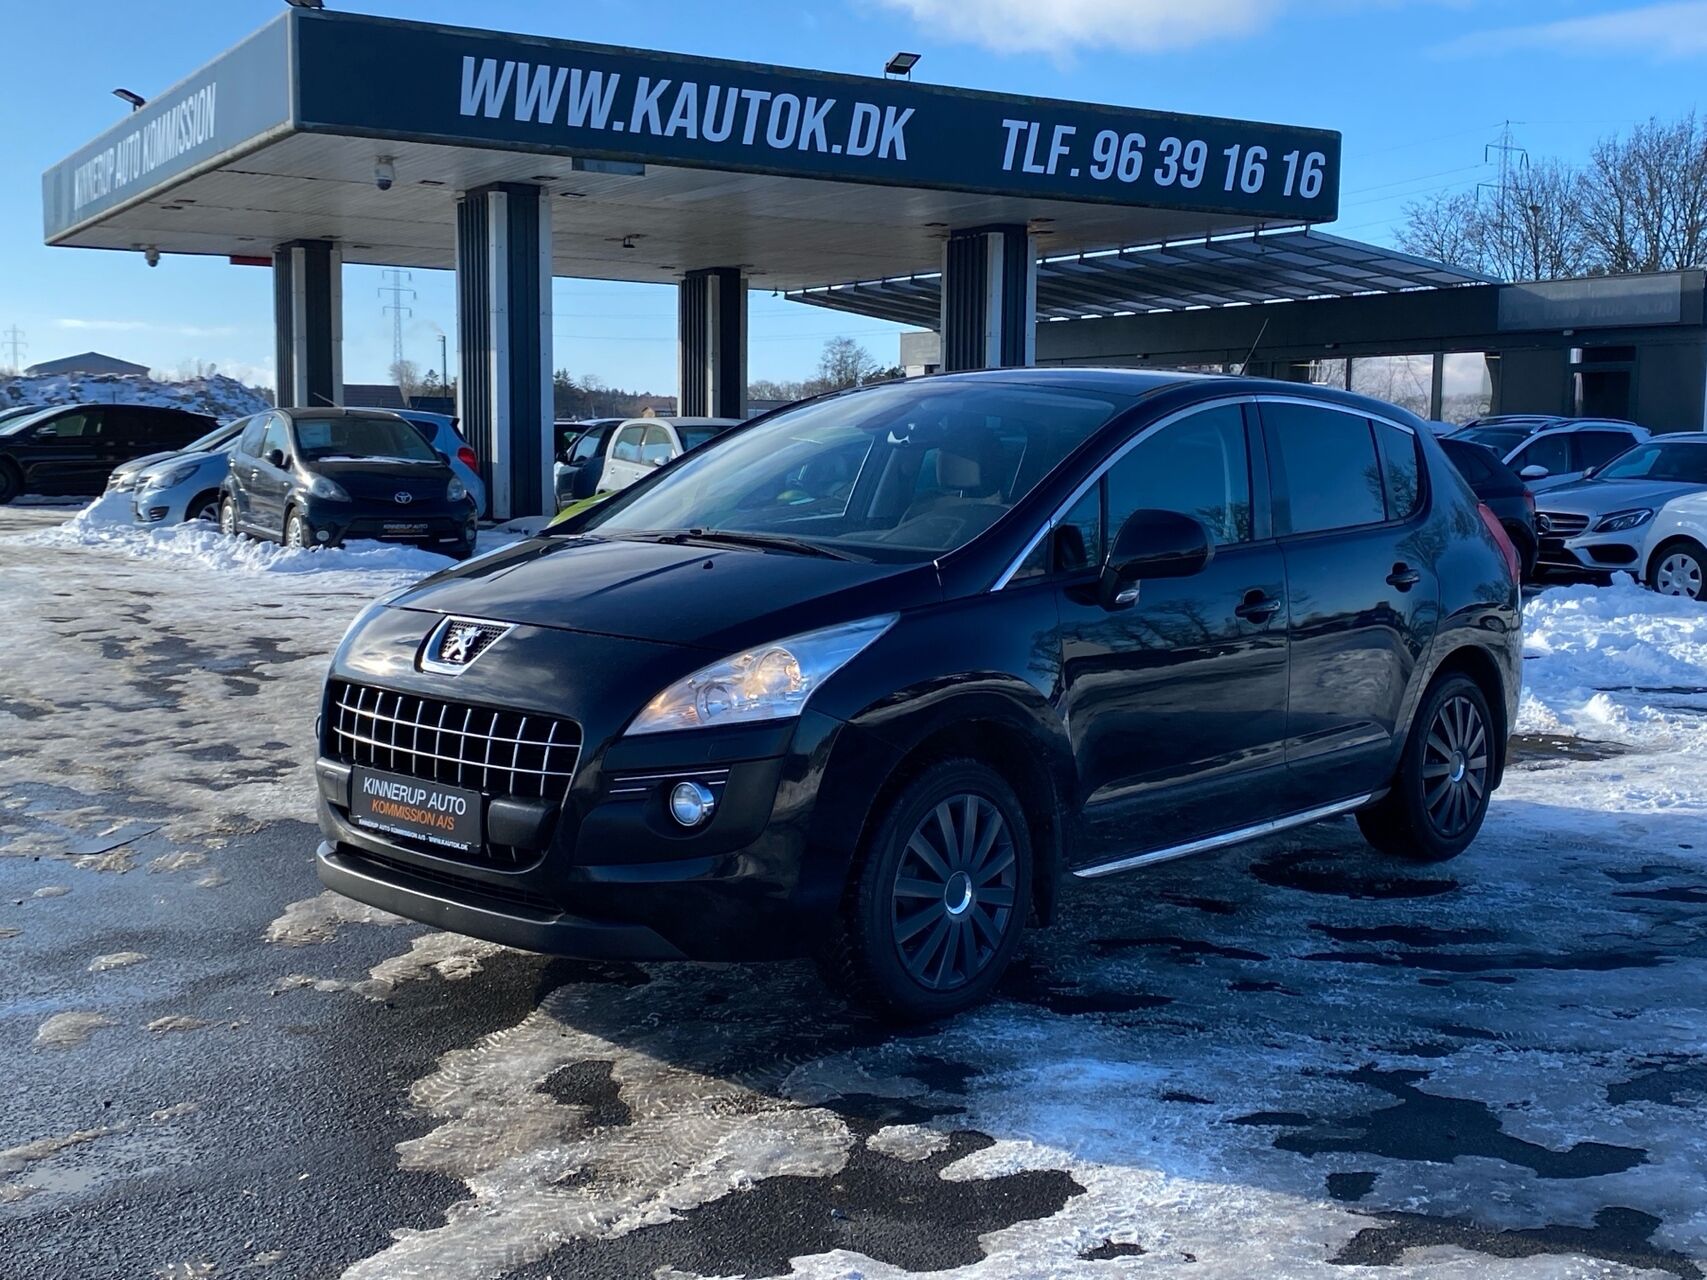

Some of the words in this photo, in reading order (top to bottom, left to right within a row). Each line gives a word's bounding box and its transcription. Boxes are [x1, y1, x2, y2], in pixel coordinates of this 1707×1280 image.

[115, 130, 141, 189] AUTO
[142, 82, 216, 175] KOMMISSION
[459, 55, 916, 161] WWW.KAUTOK.DK
[1002, 119, 1079, 177] TLF.
[1090, 130, 1146, 183] 96
[1154, 136, 1208, 189] 39
[1223, 144, 1268, 194] 16
[1282, 150, 1326, 199] 16
[363, 776, 426, 806] KINNERUP
[427, 792, 467, 816] AUTO
[371, 799, 437, 826] KOMMISSION
[436, 814, 455, 831] A/S
